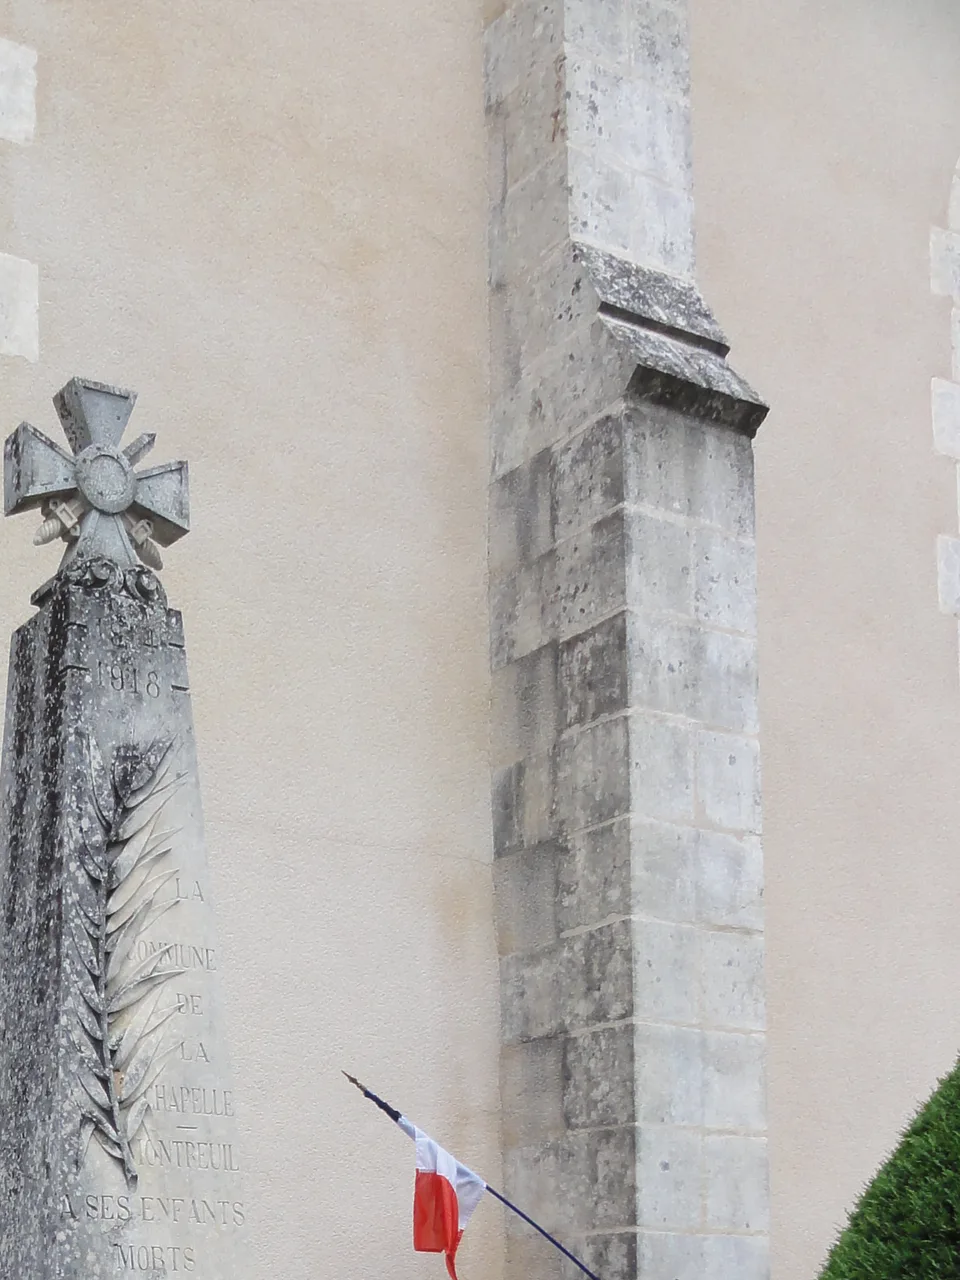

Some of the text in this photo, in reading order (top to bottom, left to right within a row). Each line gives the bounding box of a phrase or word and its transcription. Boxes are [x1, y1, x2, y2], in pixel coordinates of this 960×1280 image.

[97, 660, 160, 699] 1918
[176, 992, 203, 1016] DE
[180, 1041, 210, 1063] LA
[61, 1193, 246, 1227] A SES ENFANTS
[114, 1243, 196, 1272] MORTS
